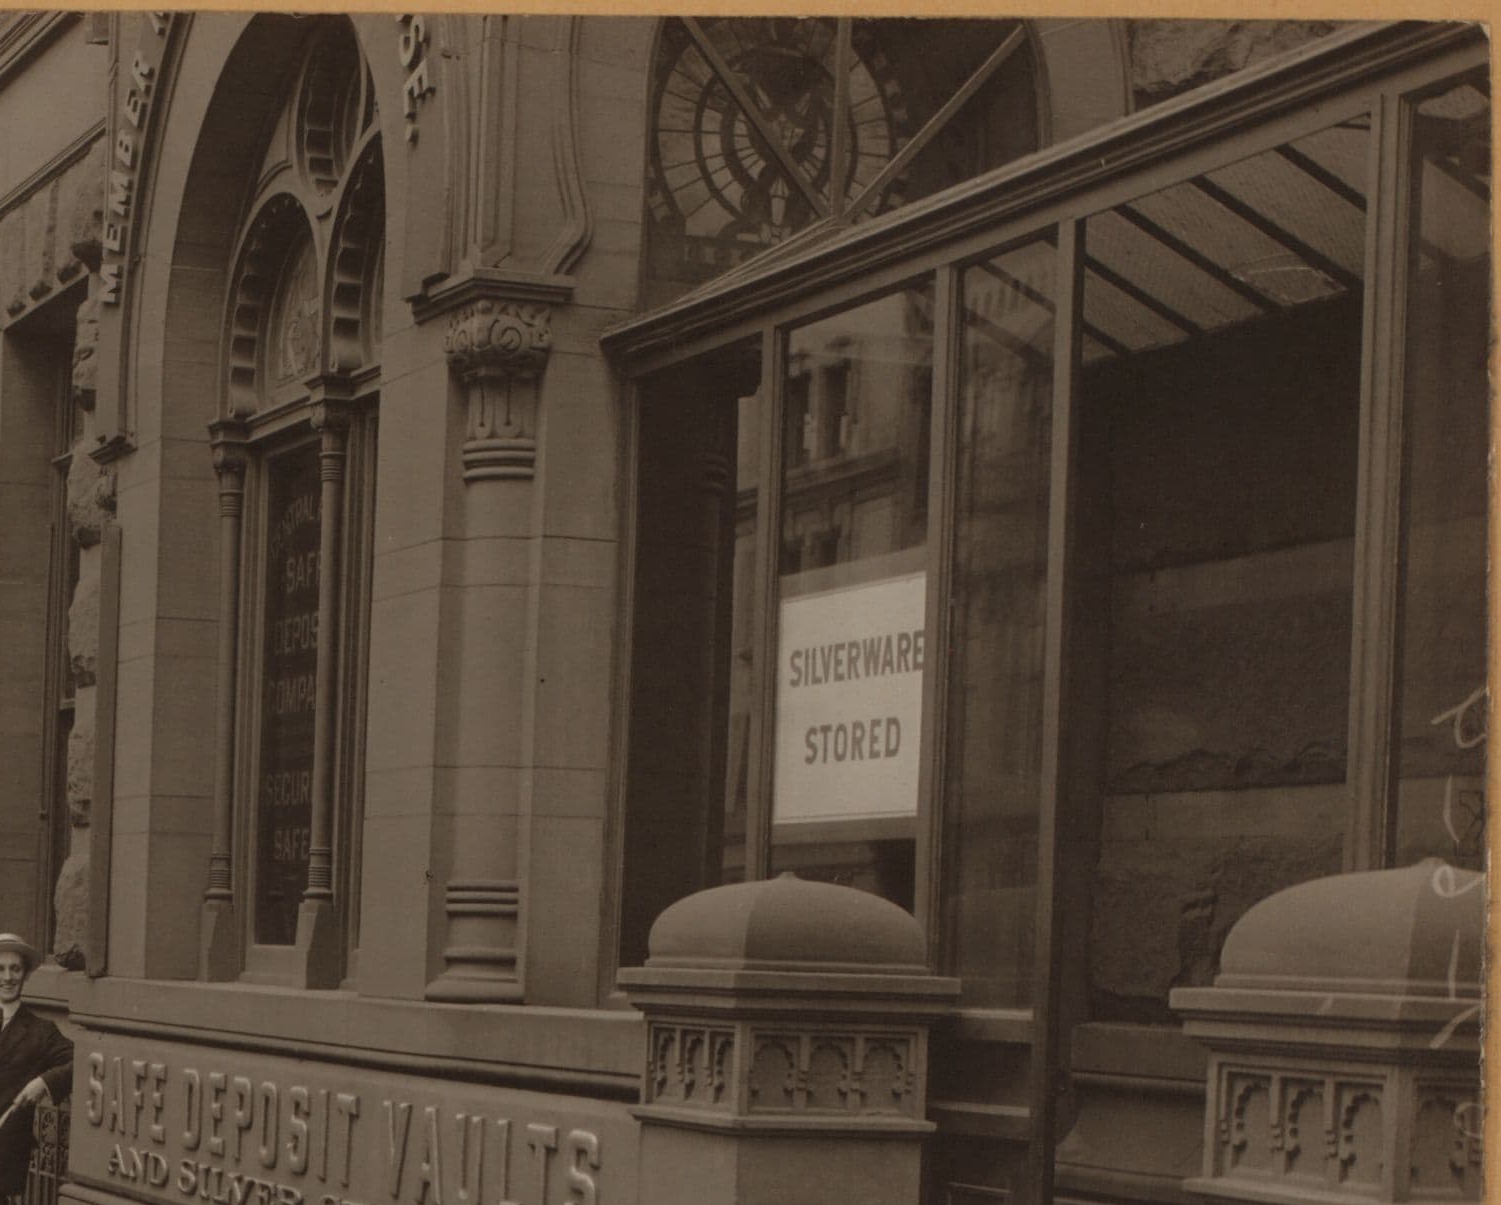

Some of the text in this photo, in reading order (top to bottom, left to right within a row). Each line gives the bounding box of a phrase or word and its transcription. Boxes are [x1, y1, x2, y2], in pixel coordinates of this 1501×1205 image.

[788, 630, 924, 688] SILVERWARE
[803, 716, 901, 765] STORED
[86, 1051, 168, 1145] SAFE
[181, 1066, 361, 1188] DEPOSIT
[107, 1142, 170, 1187] AND
